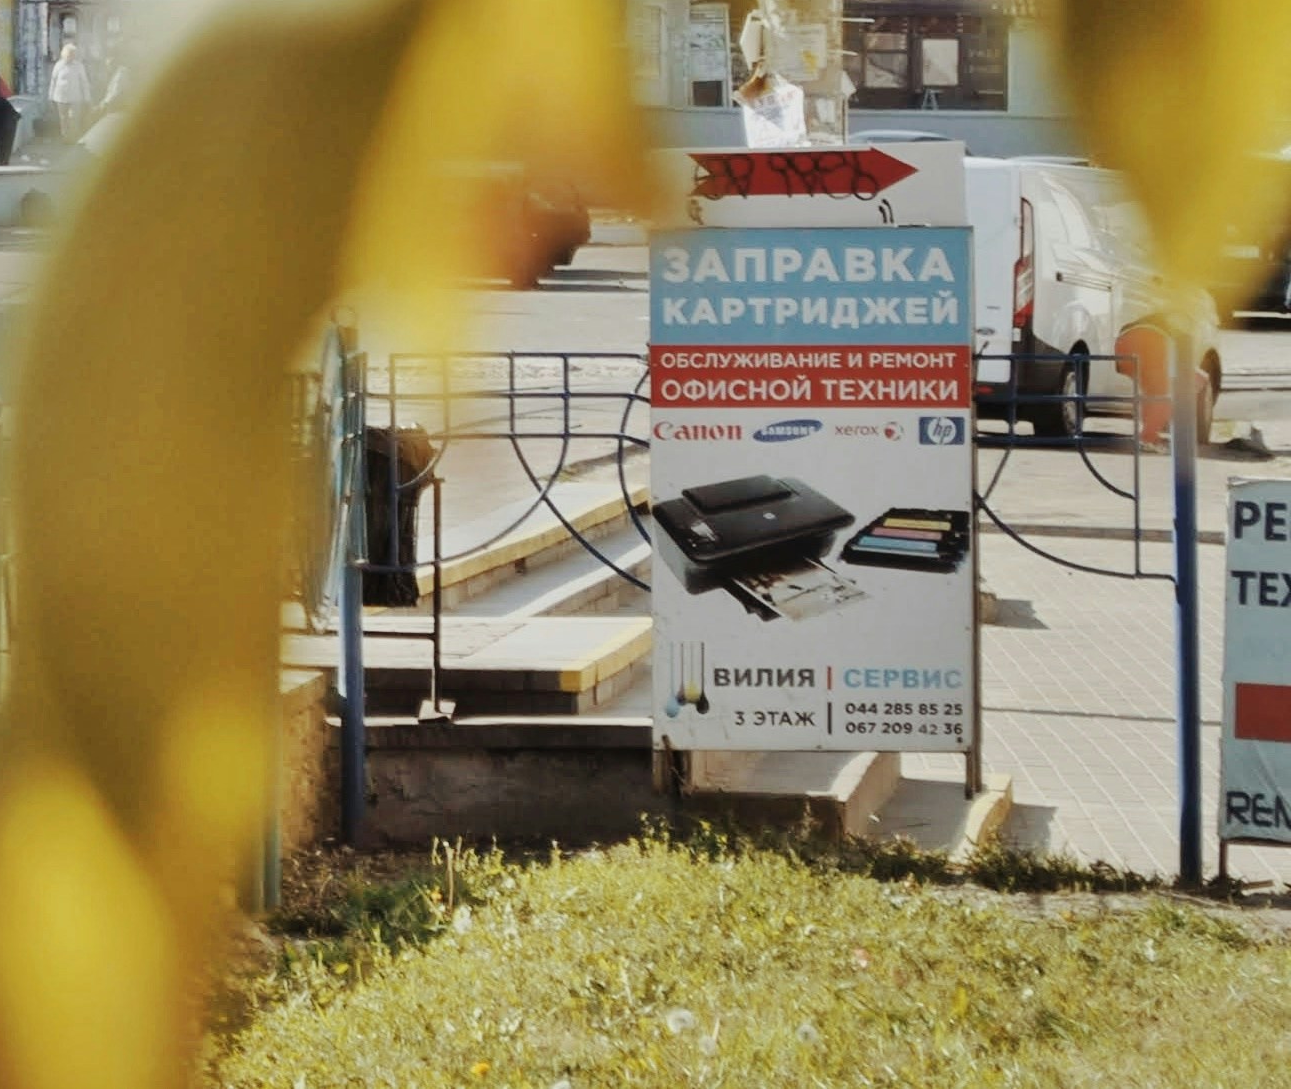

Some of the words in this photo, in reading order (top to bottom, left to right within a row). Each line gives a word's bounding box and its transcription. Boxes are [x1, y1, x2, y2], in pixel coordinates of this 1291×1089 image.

[662, 247, 955, 283] ЗАПРАВКА
[662, 290, 959, 329] КАРТРИДЖЕЙ
[661, 352, 841, 369] ОБСЛУЖИВАНИЕ
[848, 353, 863, 368] И
[869, 352, 957, 368] РЕМОНТ
[661, 374, 812, 402] ОФИСНОЙ
[822, 379, 959, 401] ТЕХНИКИ
[653, 421, 743, 441] Canon
[834, 424, 879, 437] xerox
[713, 668, 816, 688] ВИЛИЯ
[843, 668, 964, 689] СЕРВИС
[734, 711, 746, 726] 3
[753, 711, 816, 726] ЭТАЖ
[845, 702, 878, 715] 044
[884, 702, 913, 715] 285
[918, 703, 939, 715] 85
[943, 703, 963, 716] 25
[845, 722, 876, 734] 067
[882, 722, 913, 734] 209
[918, 724, 938, 735] 42
[943, 723, 963, 735] 36
